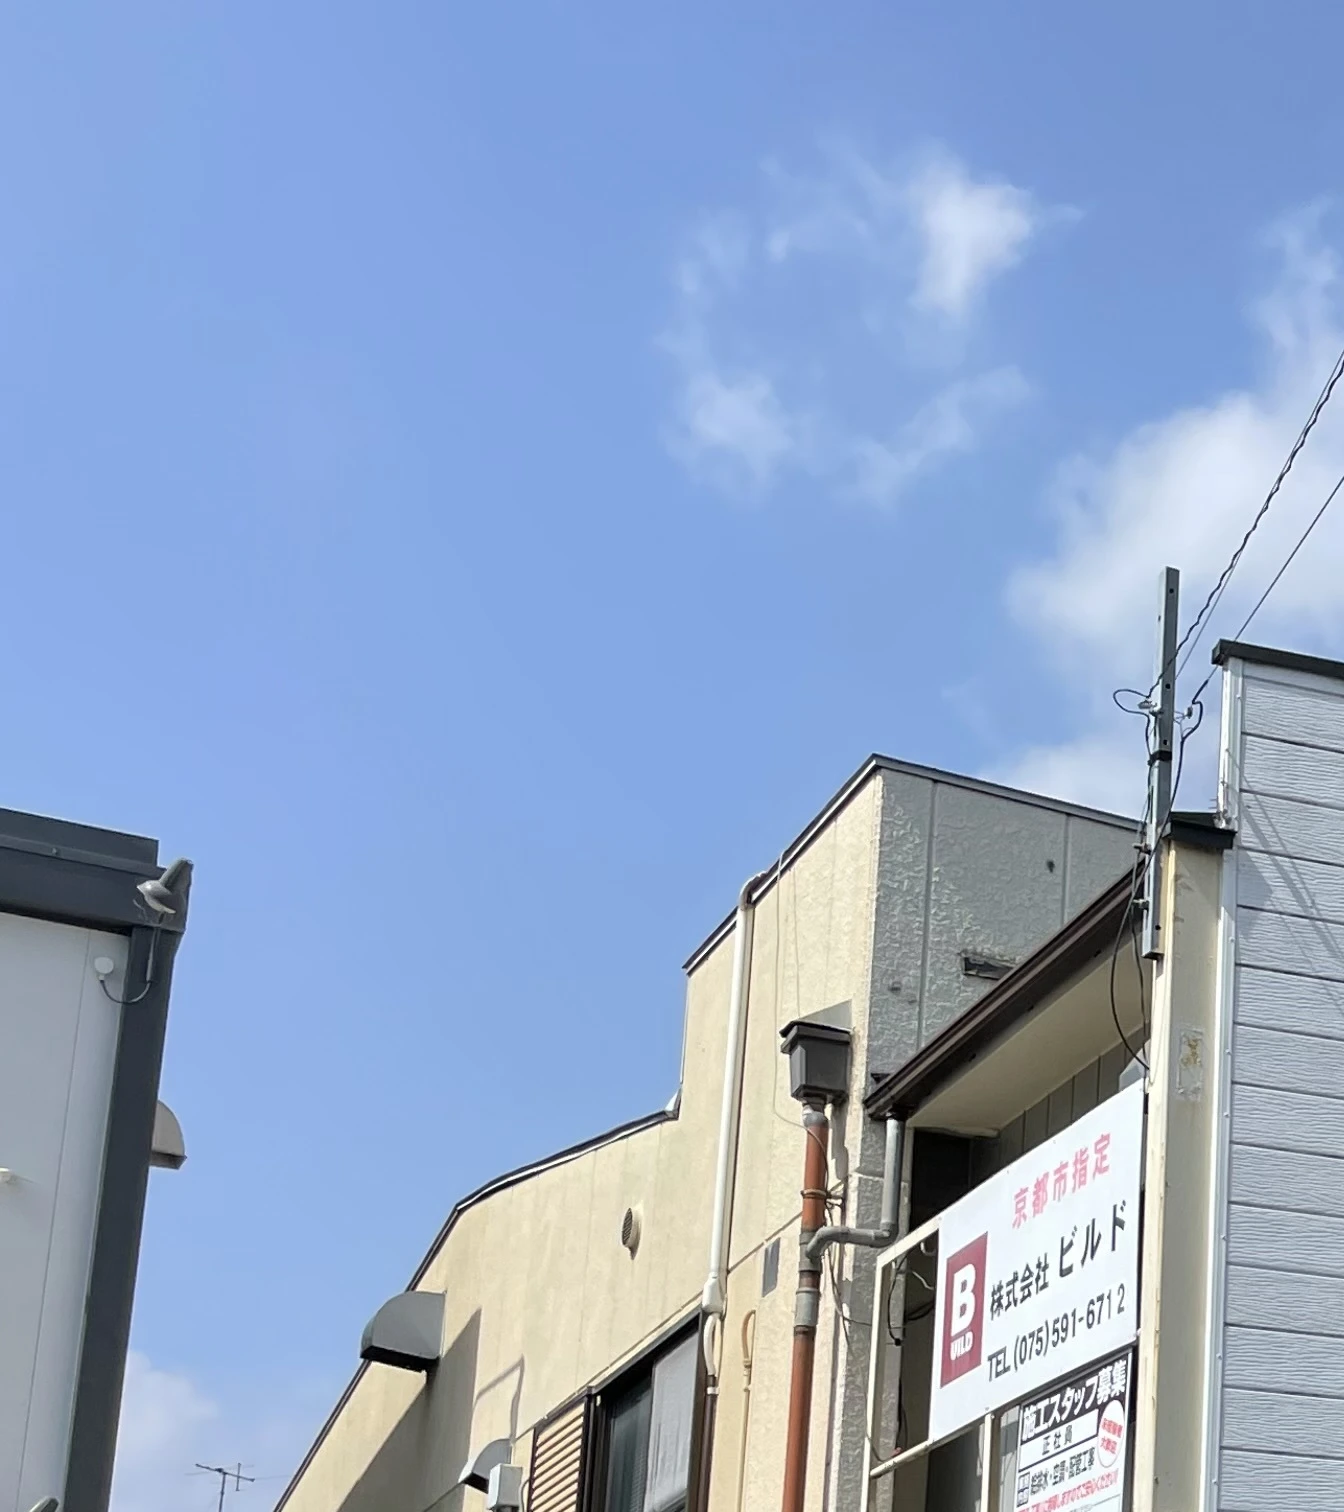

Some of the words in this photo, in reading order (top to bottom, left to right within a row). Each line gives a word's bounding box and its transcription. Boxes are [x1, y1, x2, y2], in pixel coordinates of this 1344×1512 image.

[1012, 1133, 1112, 1230] 京都市指定
[990, 1252, 1050, 1321] 株式会社
[1059, 1200, 1127, 1278] ビルド
[1022, 1359, 1127, 1441] 施工スタッフ募集
[1042, 1425, 1073, 1456] 正社員
